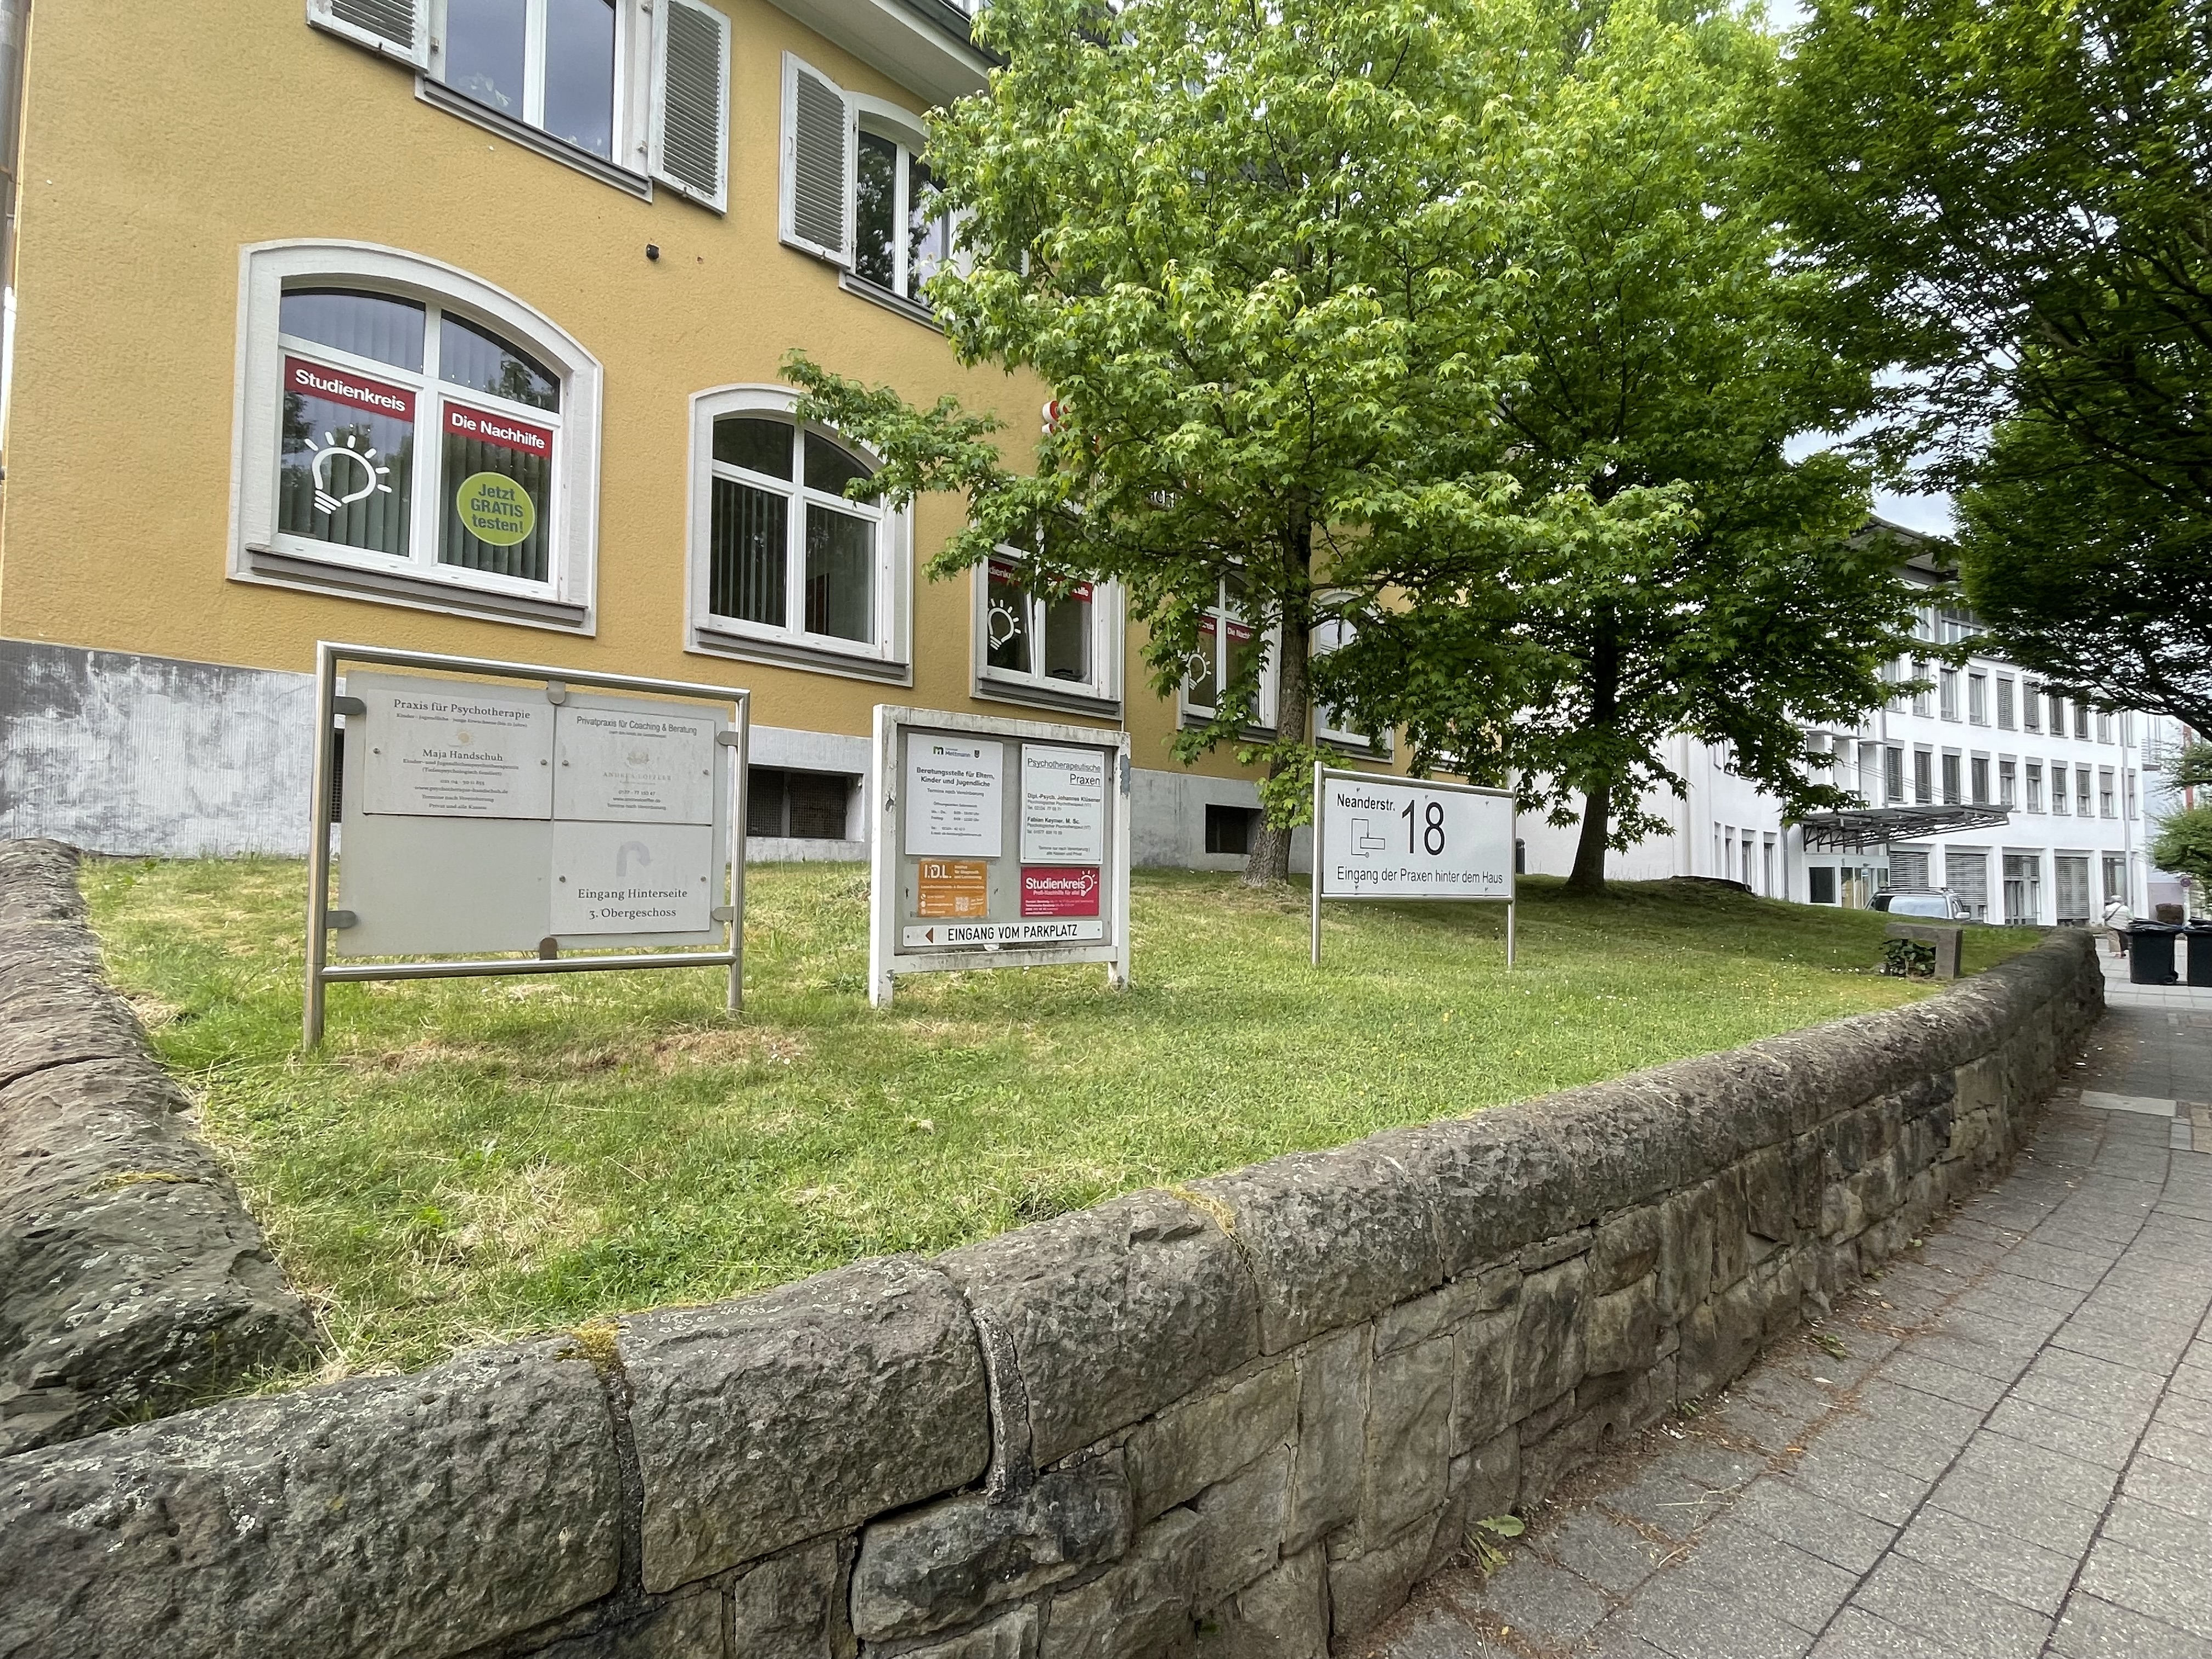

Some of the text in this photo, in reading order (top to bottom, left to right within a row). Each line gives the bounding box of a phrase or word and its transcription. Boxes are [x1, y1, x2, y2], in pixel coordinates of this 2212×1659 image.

[295, 368, 406, 412] Studienkreis
[451, 412, 546, 449] Die Nachhilfe
[478, 483, 516, 501] Jetzt
[471, 497, 524, 518] GRATIS
[471, 514, 524, 534] testen!
[393, 698, 531, 720] Praxis für Psychotherapie
[577, 715, 617, 728] Privatpraxis
[618, 719, 628, 729] für
[629, 720, 661, 732] Coaching
[661, 723, 667, 732] &
[668, 724, 697, 736] Beratung
[422, 748, 504, 761] Maja Handschuh
[916, 766, 964, 777] Beratungsstelle
[975, 771, 995, 780] Eltern,
[1027, 758, 1101, 772] Psychotherapeutische
[921, 776, 941, 784] Kinder
[956, 779, 991, 788] Jugendliche
[1069, 773, 1101, 786] Praxen
[1336, 793, 1396, 811] Neanderstr.
[1401, 799, 1445, 856] 18
[924, 864, 952, 879] I.D.L.
[1337, 866, 1503, 884] Eingang der Praxen hinter dem Haus
[1025, 877, 1086, 890] Studienkreis
[578, 888, 688, 901] Eingang Hinterseite
[589, 907, 676, 920] 3. Obergeschoss
[947, 924, 1078, 941] EINGANG VOM PARKPLATZ
